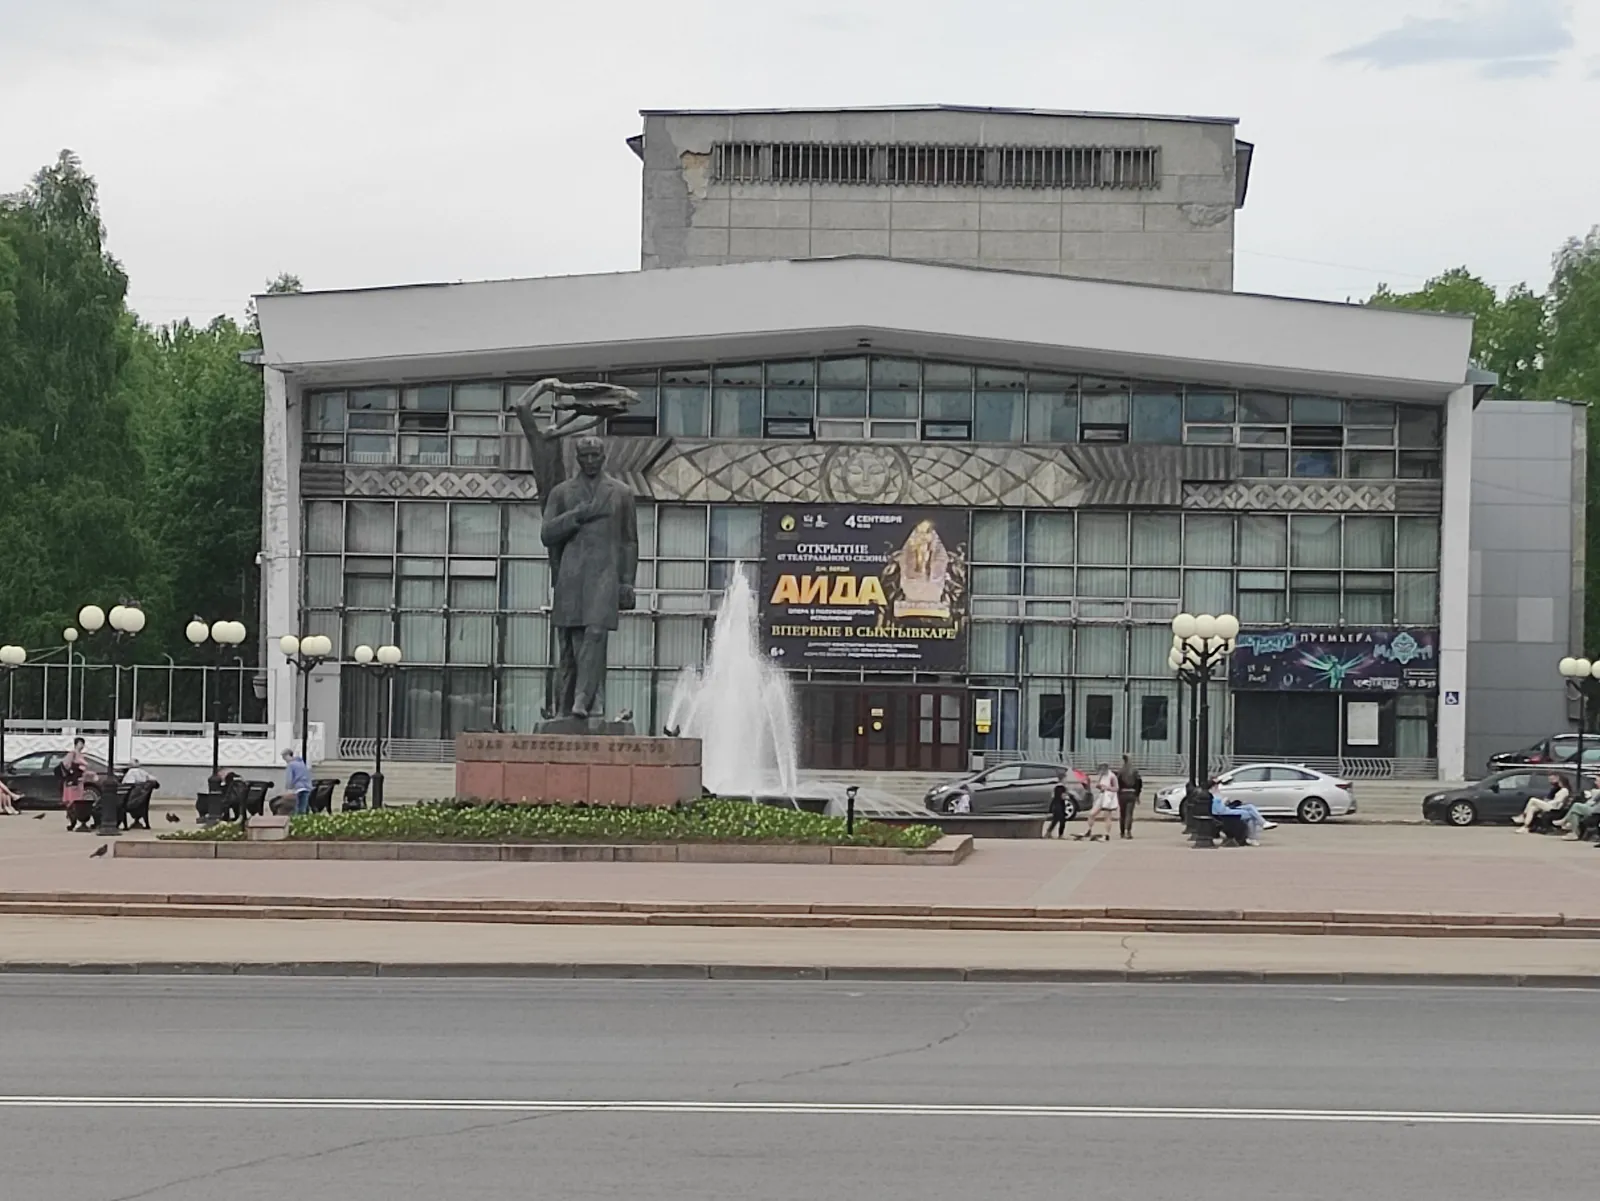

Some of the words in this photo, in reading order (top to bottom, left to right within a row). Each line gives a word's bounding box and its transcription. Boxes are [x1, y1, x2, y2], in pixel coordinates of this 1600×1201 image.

[845, 515, 856, 528] 4
[856, 515, 903, 524] СЕНТЯБРЯ
[797, 543, 869, 555] ОТКРЫТИЕ
[787, 553, 853, 562] ТЕАТРАЛЬНОГО
[770, 574, 888, 606] АИДА
[771, 625, 841, 638] ВПЕРВЫЕ
[845, 626, 854, 637] В
[1301, 632, 1372, 643] ПРЕМЬЕРА
[770, 647, 785, 657] 6+
